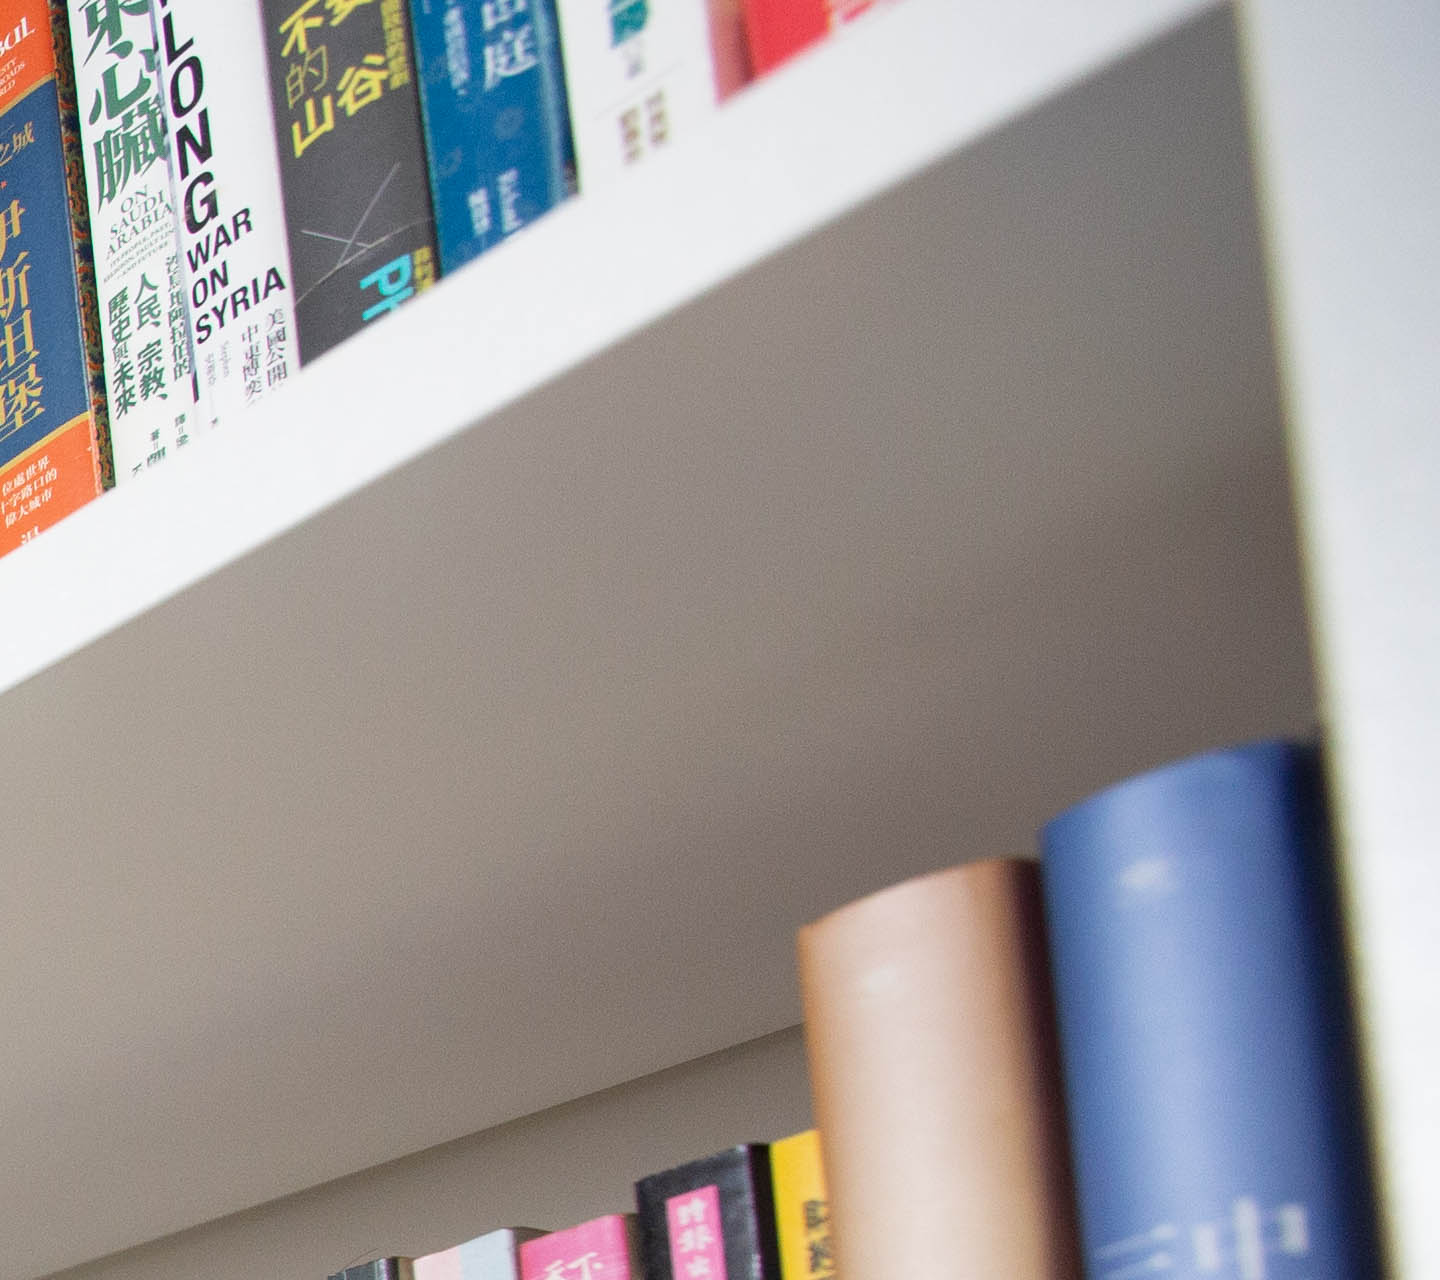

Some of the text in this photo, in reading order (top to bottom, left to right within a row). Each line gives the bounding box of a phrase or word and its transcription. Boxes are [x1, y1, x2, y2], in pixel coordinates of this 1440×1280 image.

[292, 55, 389, 158] 山谷
[110, 189, 164, 241] SAUDI
[120, 185, 148, 214] ON
[106, 202, 174, 258] ARABIA
[187, 207, 253, 274] WAR
[193, 260, 229, 309] ON
[196, 266, 285, 345] SYRIA
[108, 285, 136, 421] 歷史與未來
[134, 271, 168, 401] 人民、宗教、
[0, 467, 58, 515] 十字路口的
[2, 455, 50, 495] 位處世界
[5, 488, 54, 528] 偉大城市
